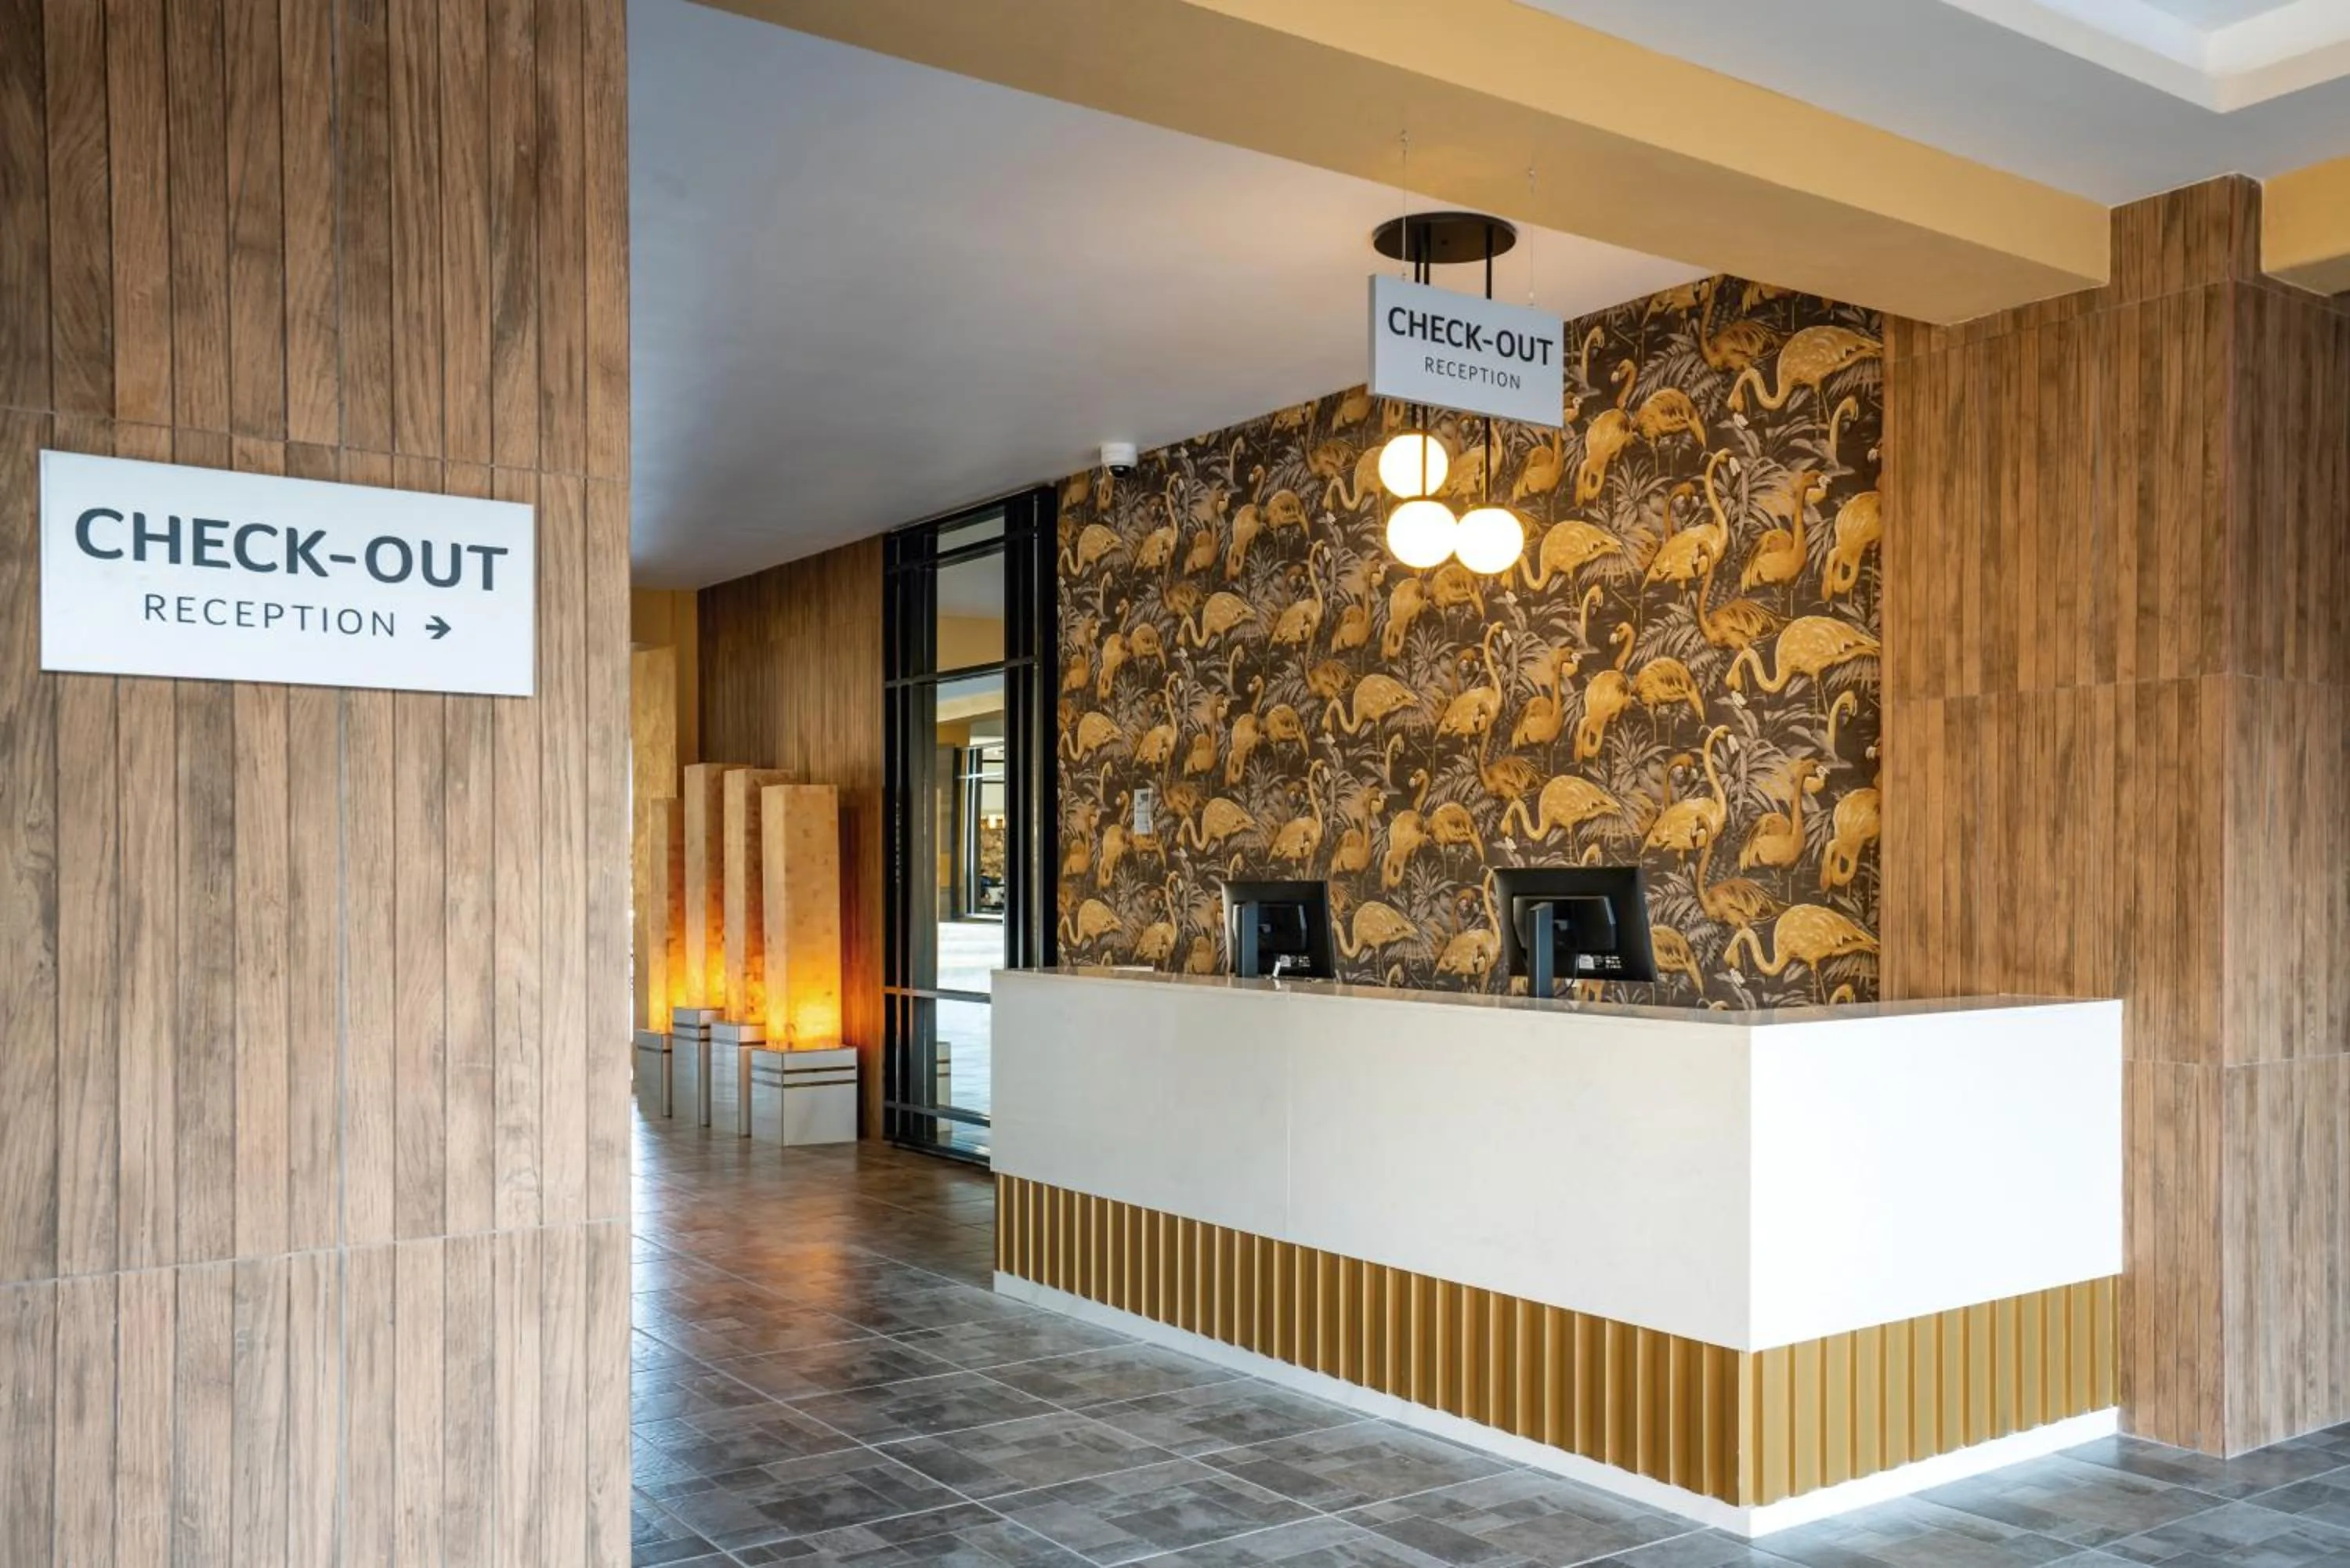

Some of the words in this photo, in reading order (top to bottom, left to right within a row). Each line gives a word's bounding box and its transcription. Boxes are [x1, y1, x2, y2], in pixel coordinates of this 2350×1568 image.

[1387, 306, 1555, 367] CHECK-OUT
[1424, 356, 1521, 390] RECEPTION
[74, 508, 508, 591] CHECK-OUT
[144, 593, 396, 637] RECEPTION
